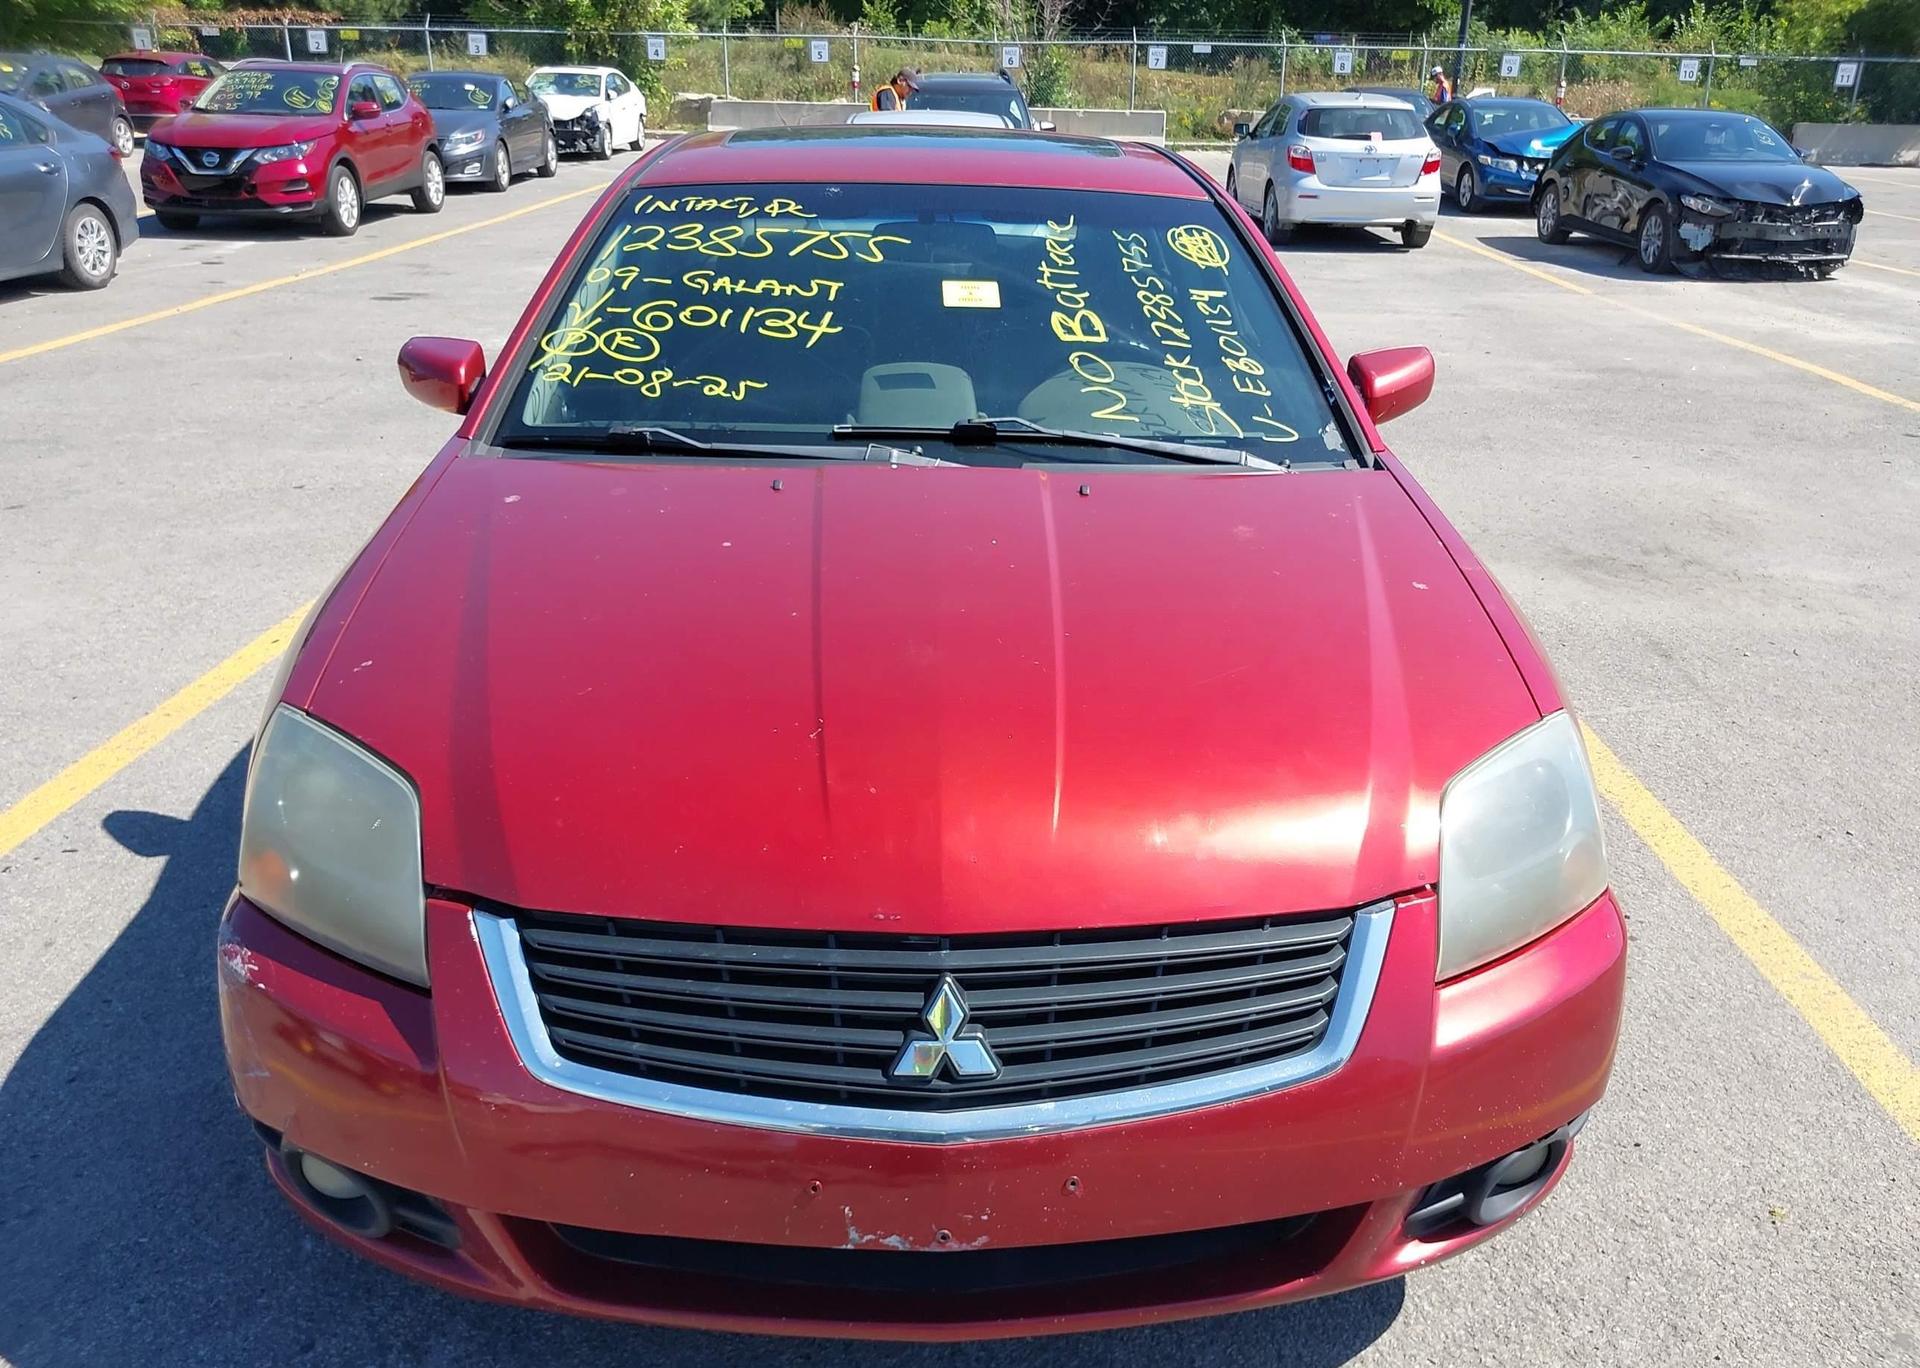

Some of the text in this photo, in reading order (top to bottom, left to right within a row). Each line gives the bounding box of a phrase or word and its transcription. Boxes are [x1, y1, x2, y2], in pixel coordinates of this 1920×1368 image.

[475, 45, 480, 53] 3
[654, 49, 659, 57] 4
[1008, 57, 1013, 65] 6
[1154, 58, 1159, 66] 7
[1507, 66, 1512, 74] 9
[1840, 75, 1850, 83] 11
[600, 223, 912, 263] 12385755
